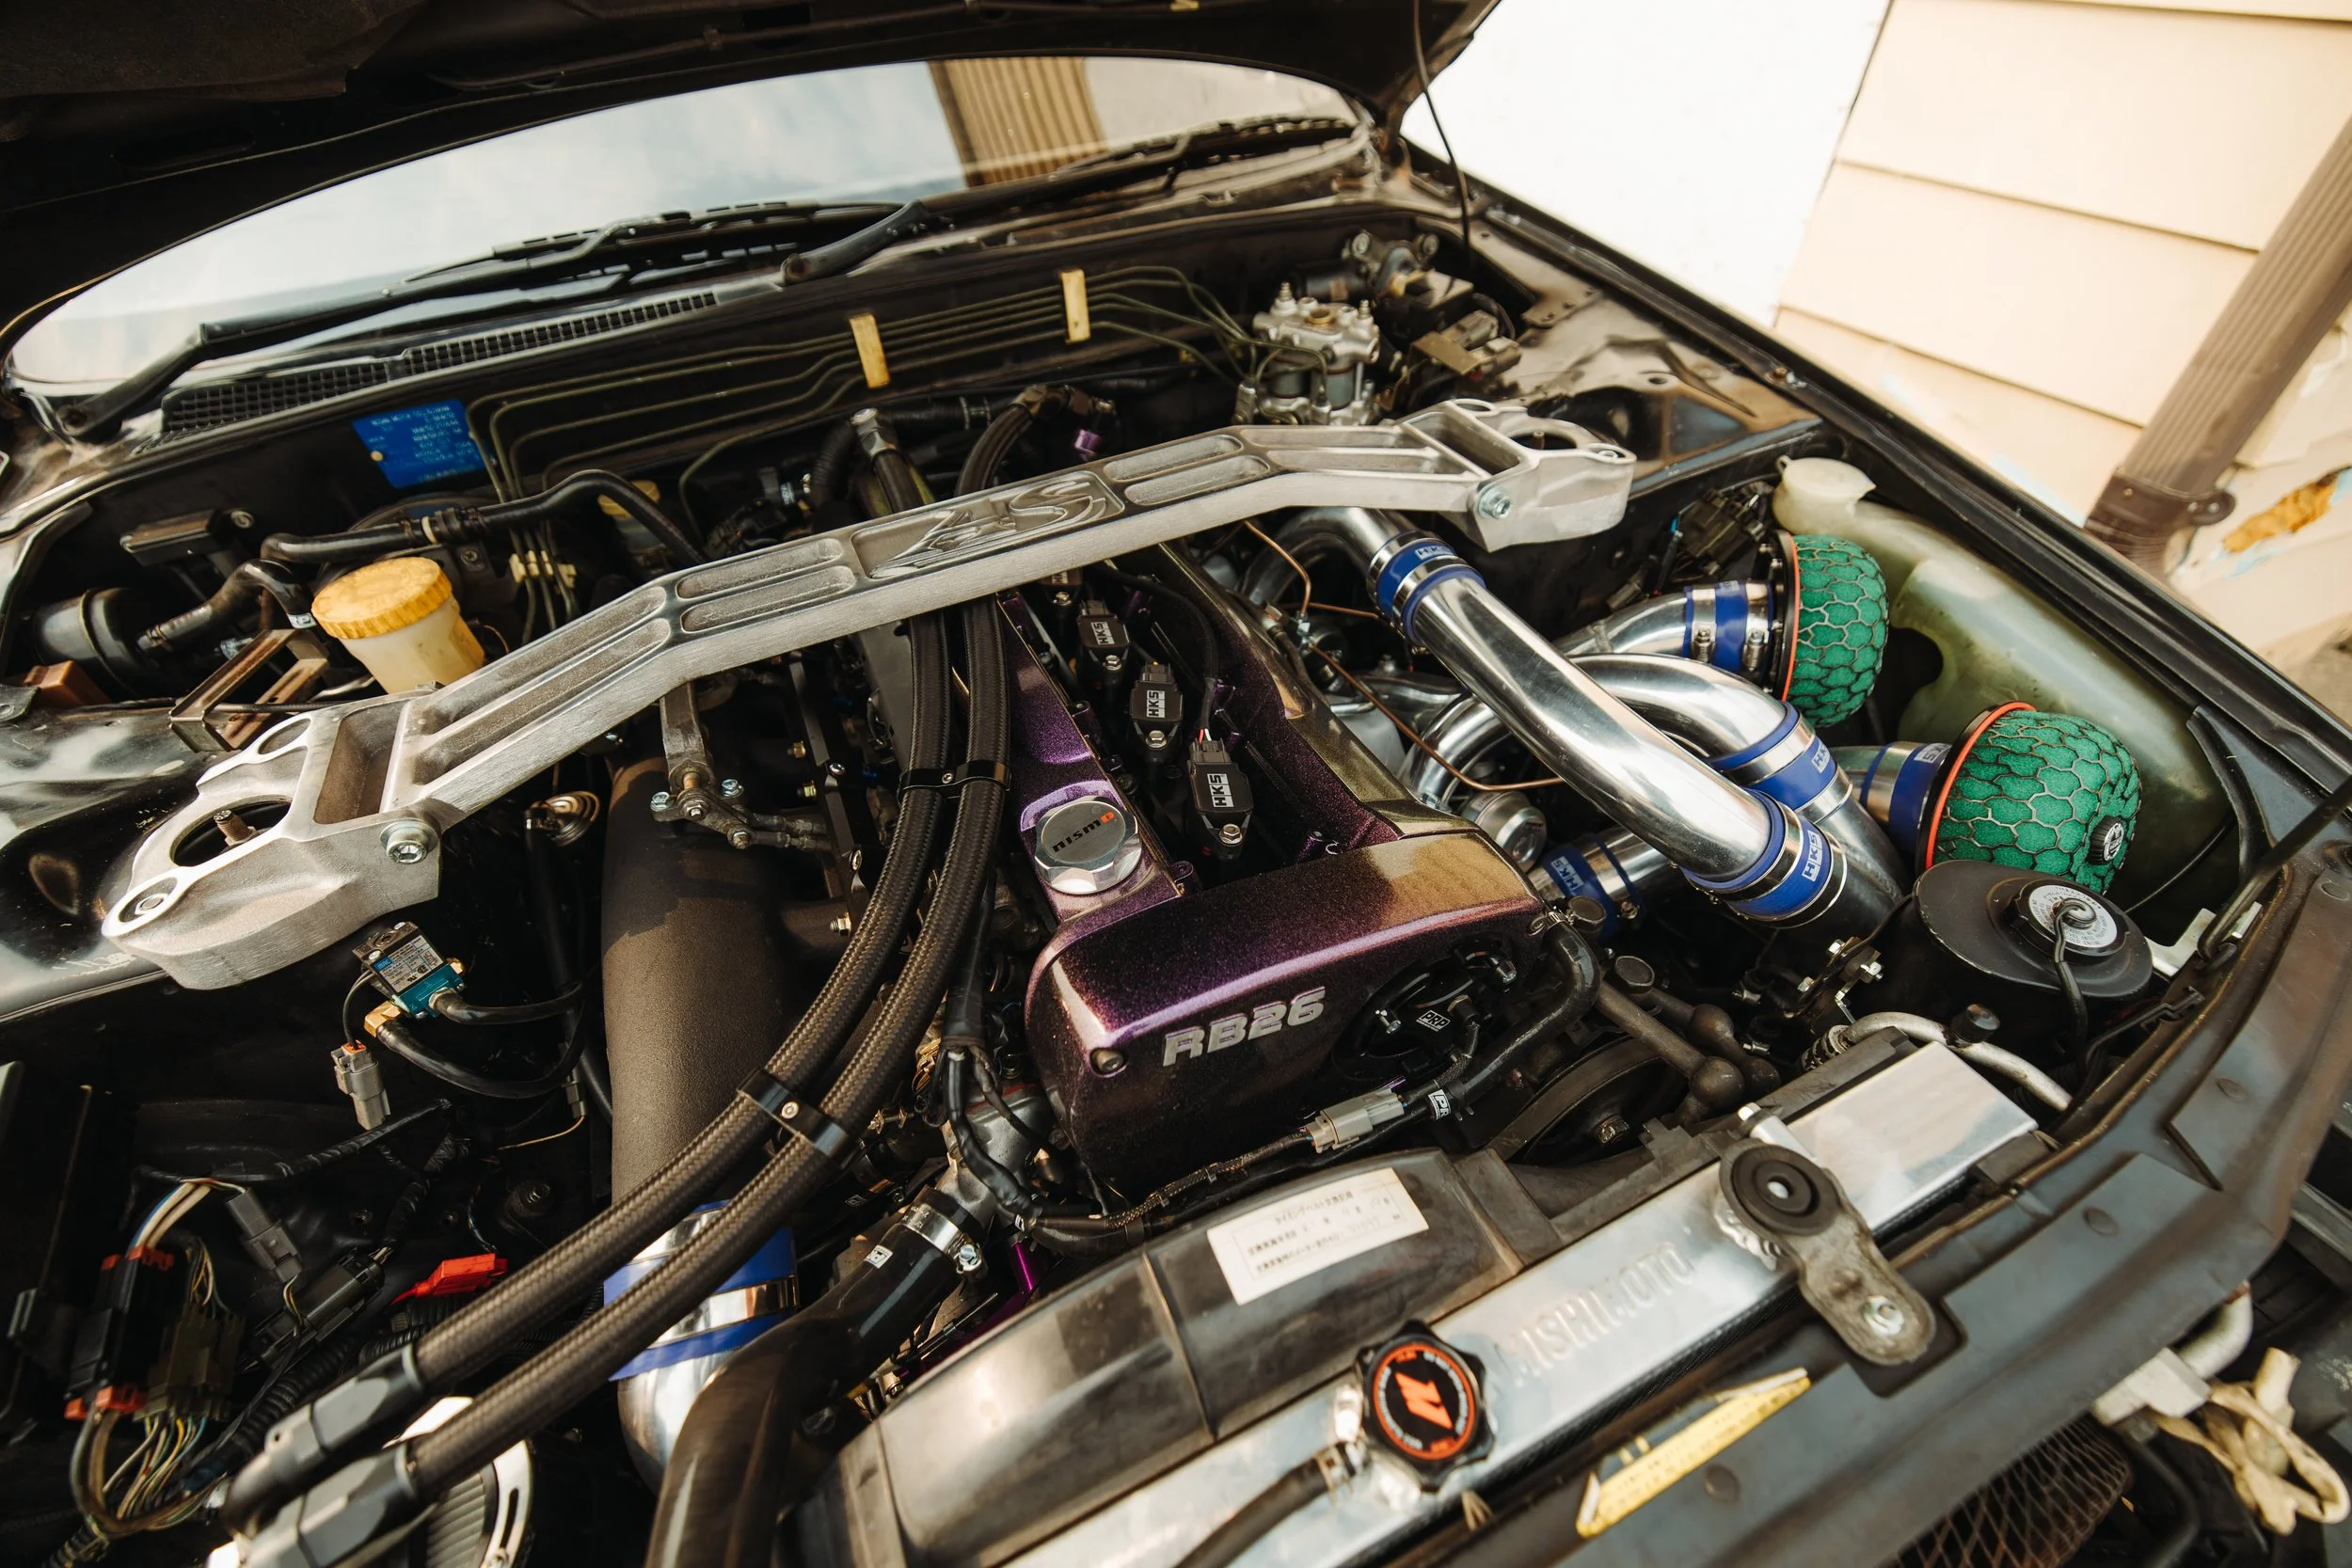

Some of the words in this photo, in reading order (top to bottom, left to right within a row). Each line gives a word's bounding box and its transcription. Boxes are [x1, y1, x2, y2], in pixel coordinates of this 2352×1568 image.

[1092, 622, 1111, 644] HKS
[1148, 690, 1160, 717] HKS
[1209, 774, 1228, 807] HKS
[1052, 812, 1115, 853] nismo
[1803, 832, 1820, 878] HKS
[1552, 858, 1581, 889] HKS
[1163, 986, 1326, 1068] RB26
